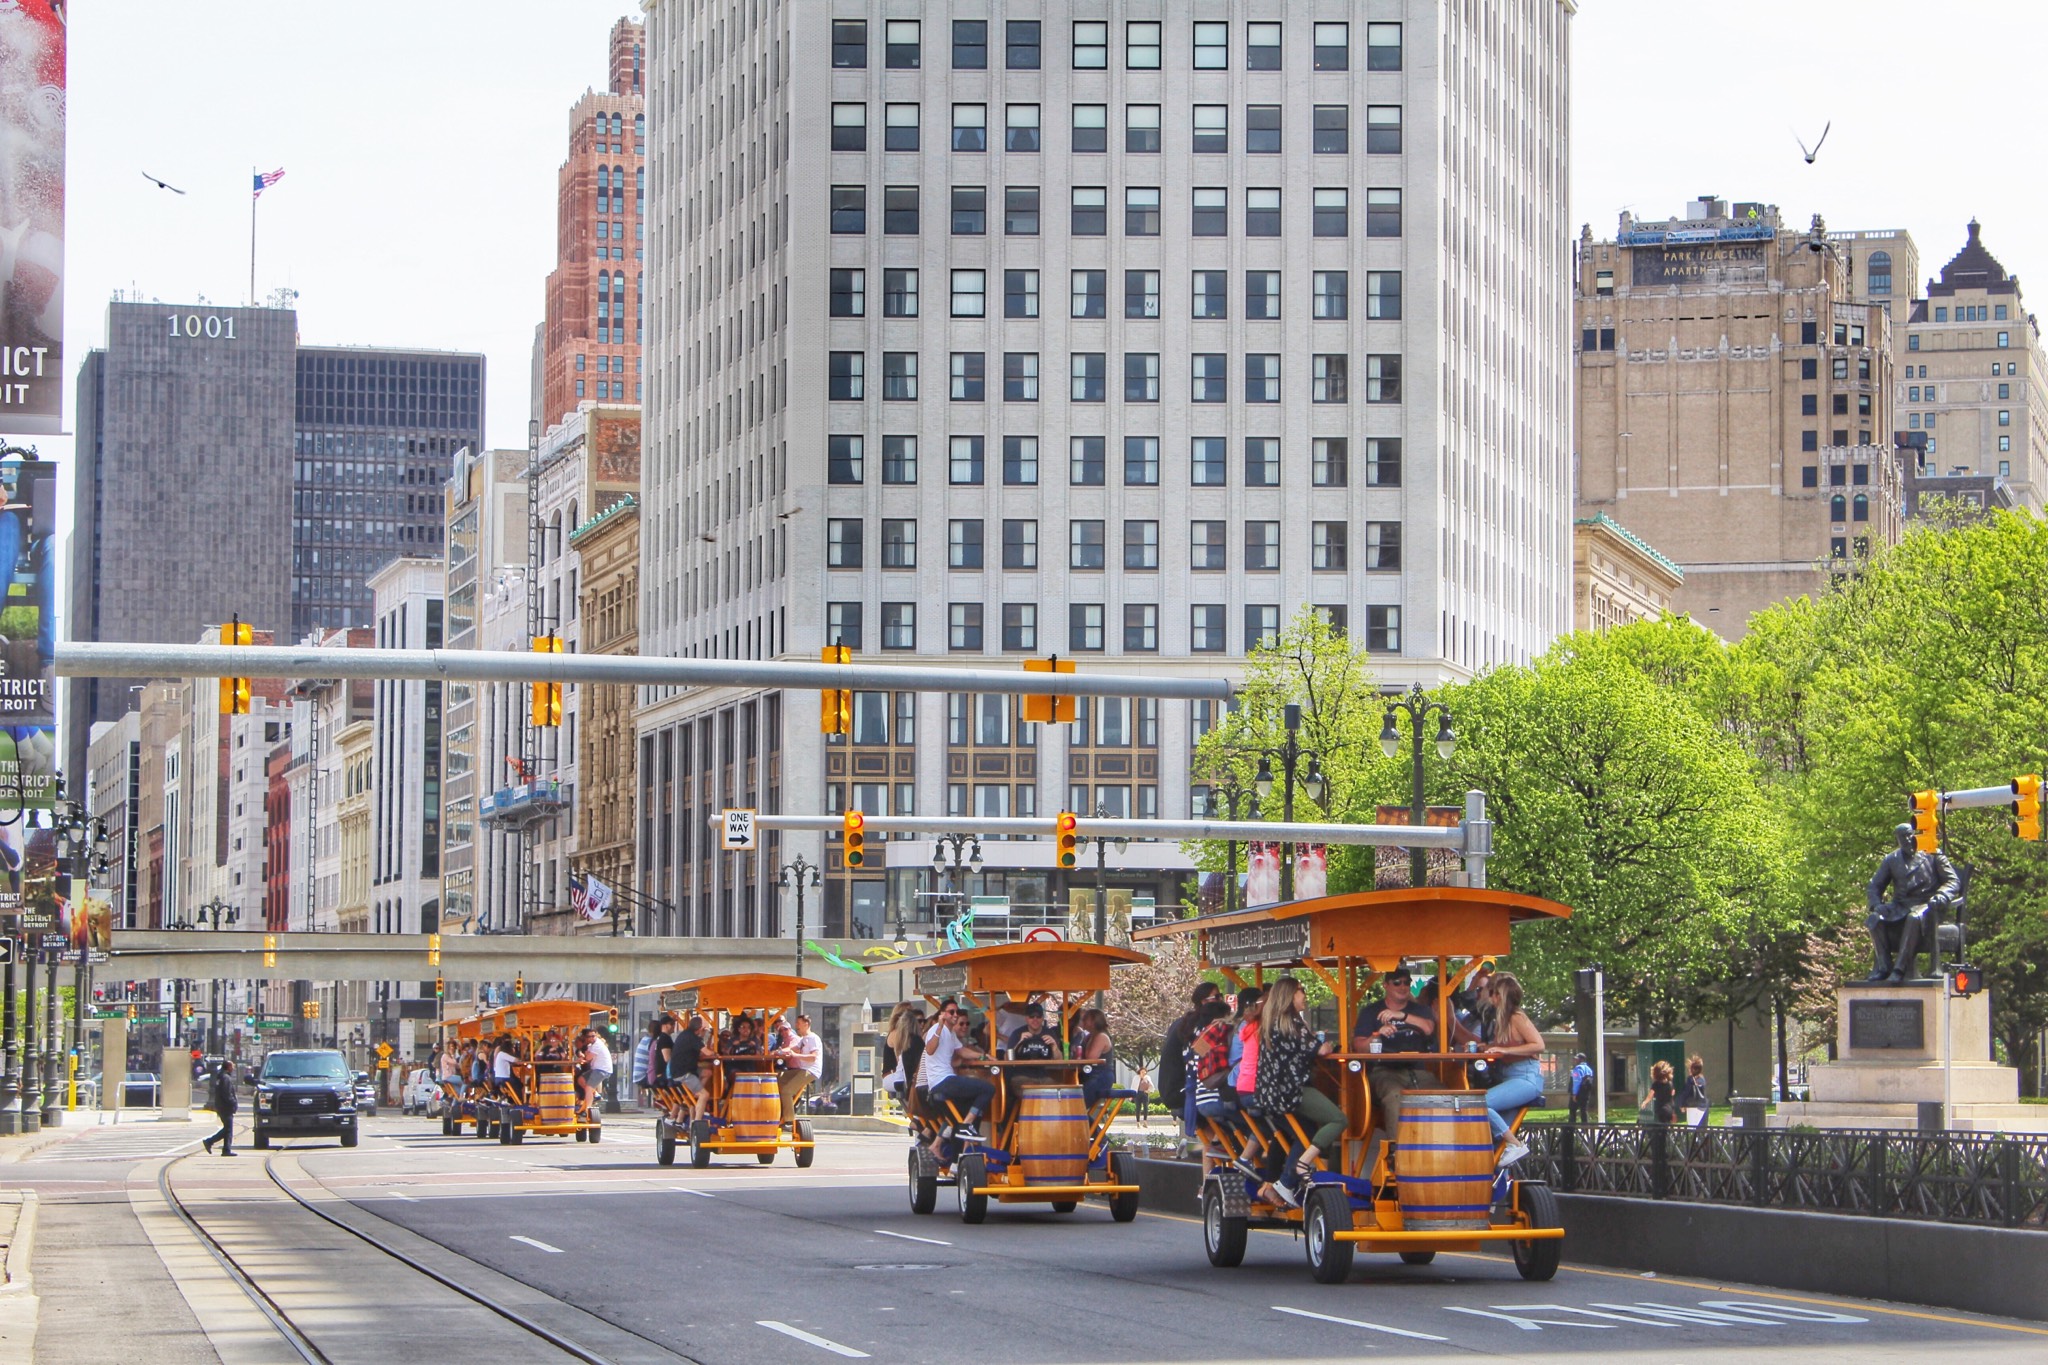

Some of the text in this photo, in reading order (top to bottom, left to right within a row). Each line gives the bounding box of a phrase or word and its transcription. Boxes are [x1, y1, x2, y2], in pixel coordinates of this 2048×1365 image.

[1664, 252, 1691, 261] PARK
[1700, 250, 1734, 261] PLACE
[168, 314, 236, 339] 1001
[0, 384, 29, 404] IT
[0, 679, 46, 695] TRICT
[730, 813, 749, 822] ONE
[730, 824, 749, 832] WAY
[1327, 936, 1335, 953] 4
[979, 977, 984, 988] 1
[702, 997, 709, 1006] 5
[1442, 1300, 1870, 1331] ONLY
